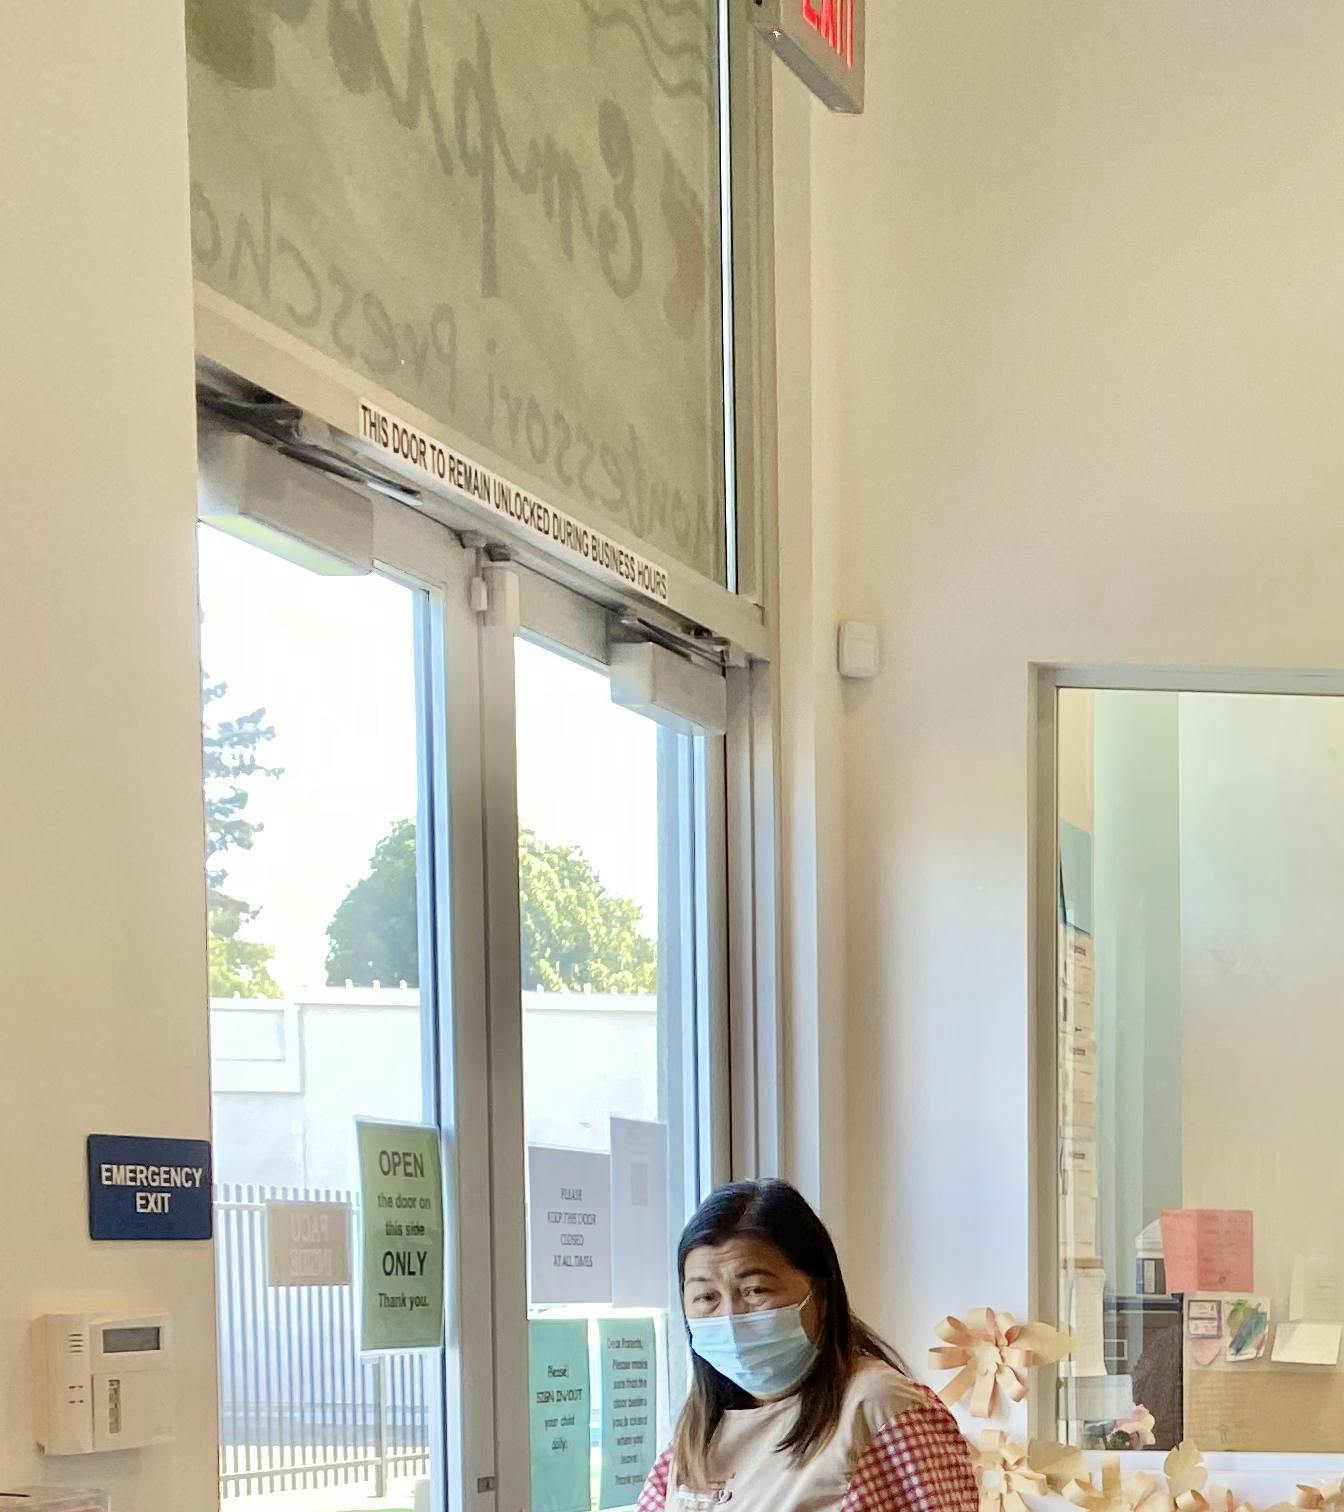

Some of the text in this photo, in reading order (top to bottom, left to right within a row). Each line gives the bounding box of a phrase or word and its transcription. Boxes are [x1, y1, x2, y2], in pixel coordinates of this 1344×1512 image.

[361, 404, 667, 600] THIS DOOR TO REMAIN UNLOCKED DURING BUSINESS HOURS
[379, 1150, 425, 1178] OPEN
[100, 1164, 203, 1188] EMERGENCY
[135, 1191, 172, 1213] EXIT
[377, 1192, 431, 1210] the door on
[385, 1220, 425, 1236] this side
[382, 1250, 428, 1276] ONLY
[378, 1292, 430, 1311] Thank you.
